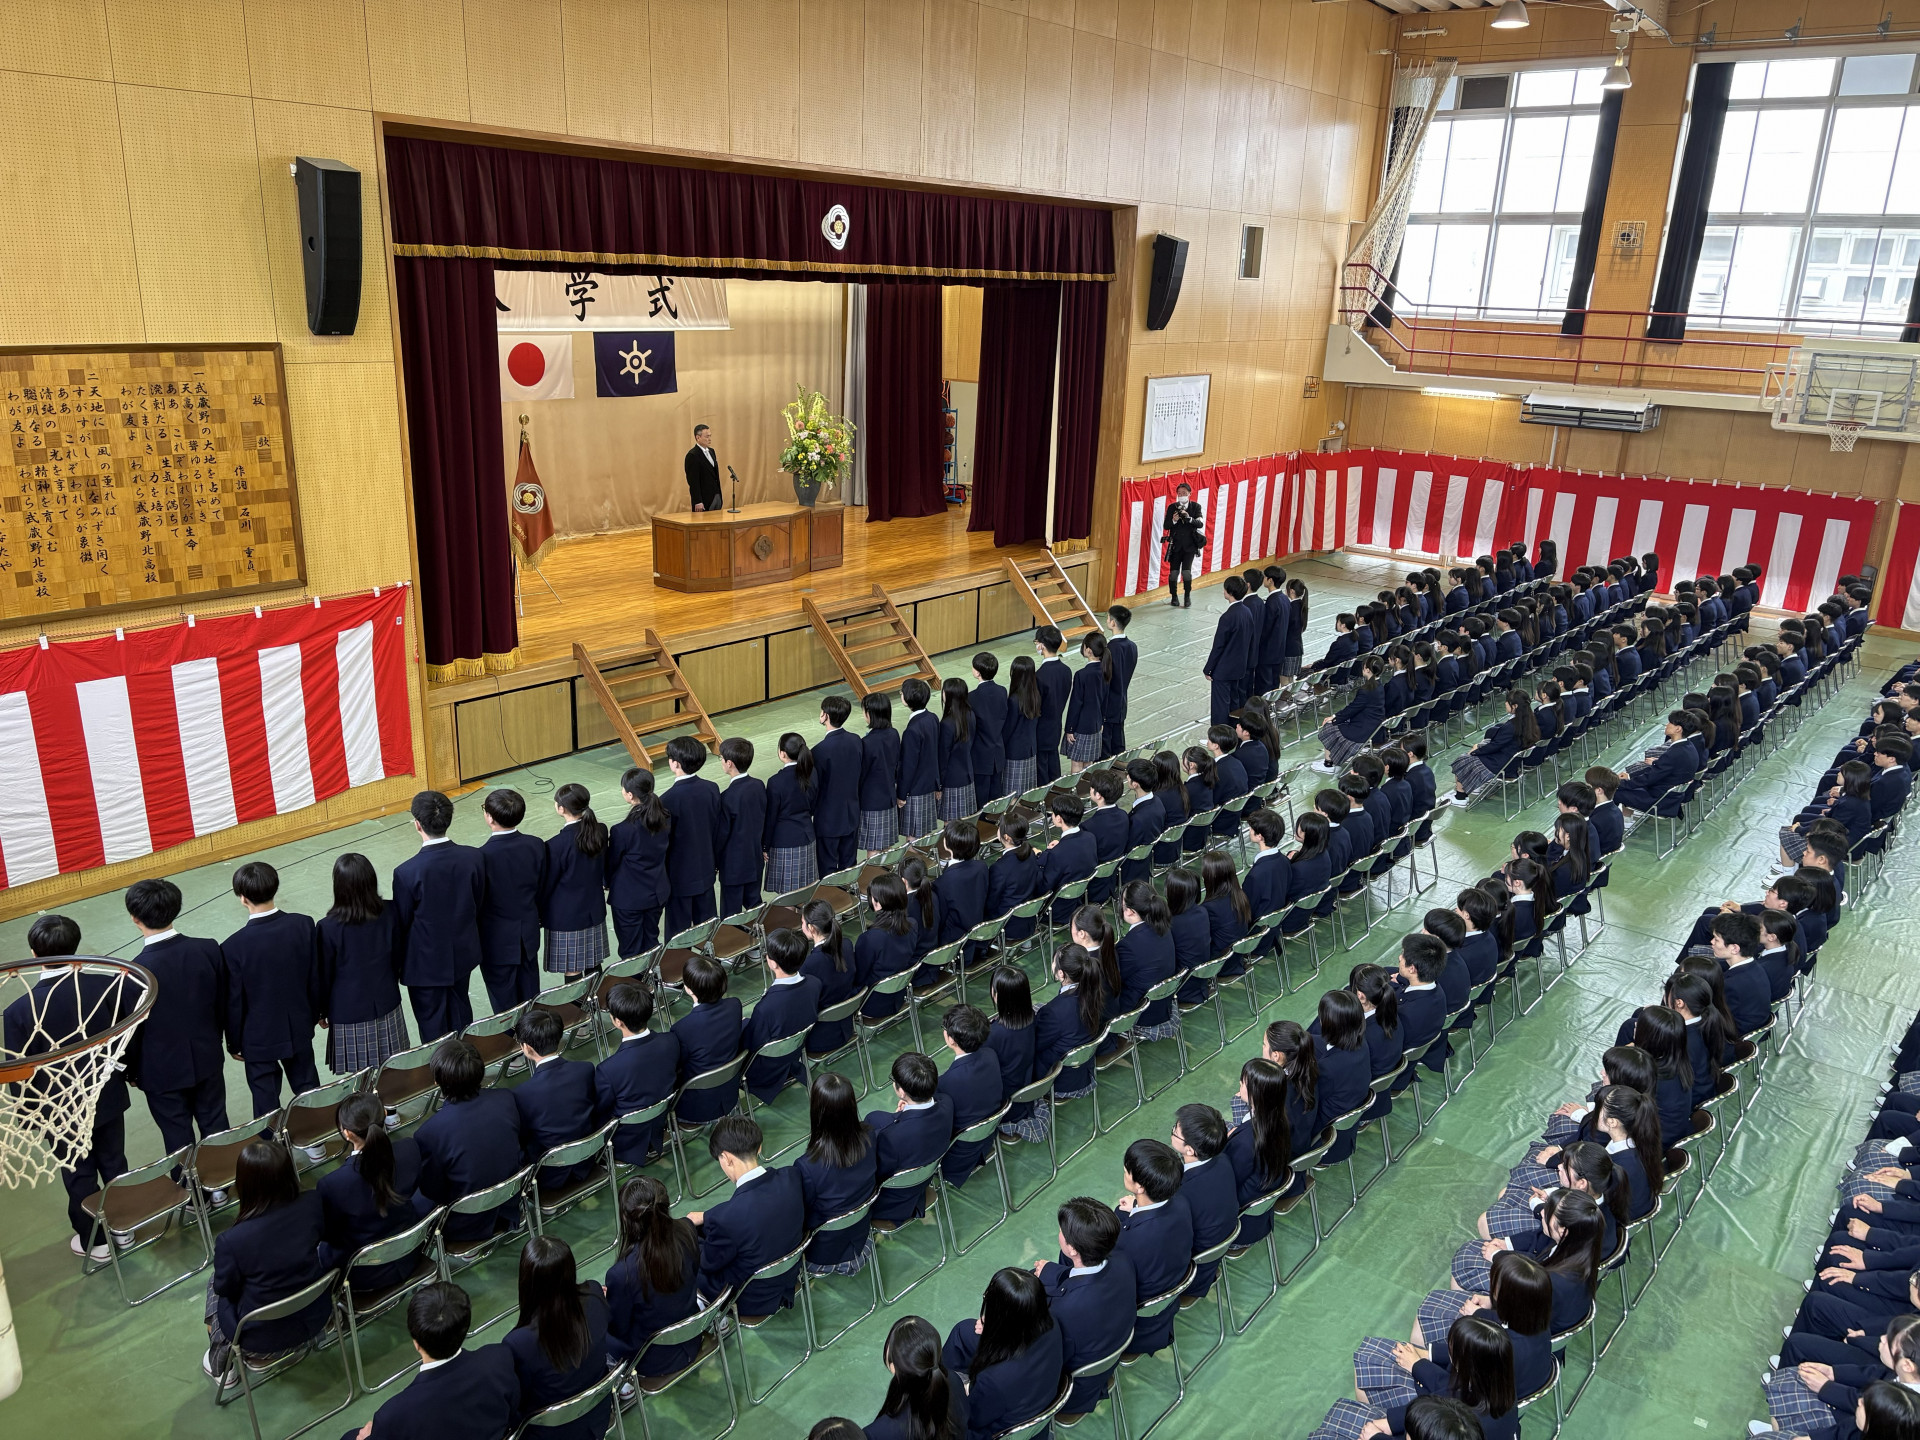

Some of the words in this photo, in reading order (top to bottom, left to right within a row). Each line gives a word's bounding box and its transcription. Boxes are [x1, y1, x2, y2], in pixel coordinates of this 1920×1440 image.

[495, 272, 678, 322] 学式
[7, 389, 26, 449] わが友よ
[57, 388, 71, 414] ああ
[120, 385, 137, 441] わが友よ
[166, 384, 179, 410] ああ
[181, 383, 195, 424] 天高く
[72, 388, 91, 458] すがすがし
[136, 385, 154, 455] たくましき
[234, 465, 248, 490] 作詞
[240, 507, 251, 531] 石川
